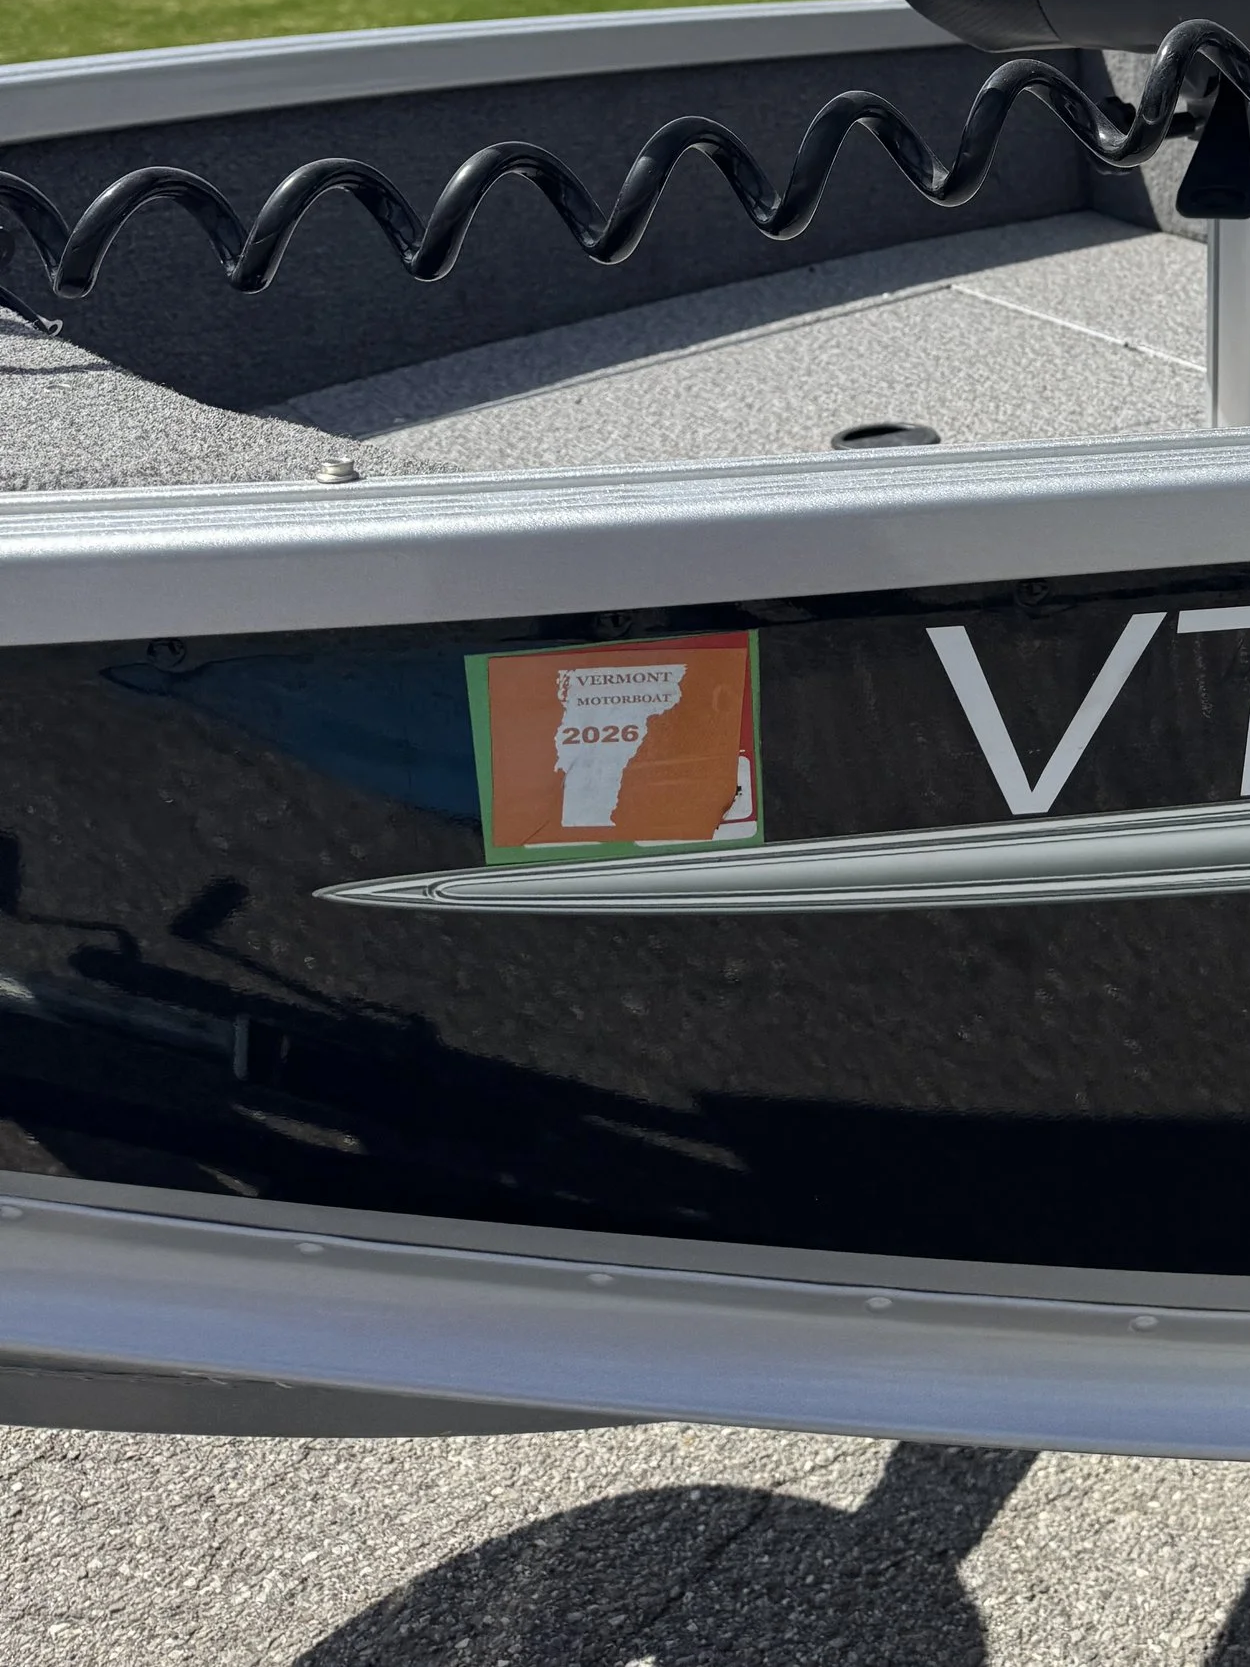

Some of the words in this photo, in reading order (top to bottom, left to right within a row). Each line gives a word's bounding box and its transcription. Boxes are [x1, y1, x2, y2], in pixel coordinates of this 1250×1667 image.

[576, 672, 673, 687] VERMONT
[577, 693, 672, 707] MOTORBOAT
[562, 724, 639, 745] 2026
